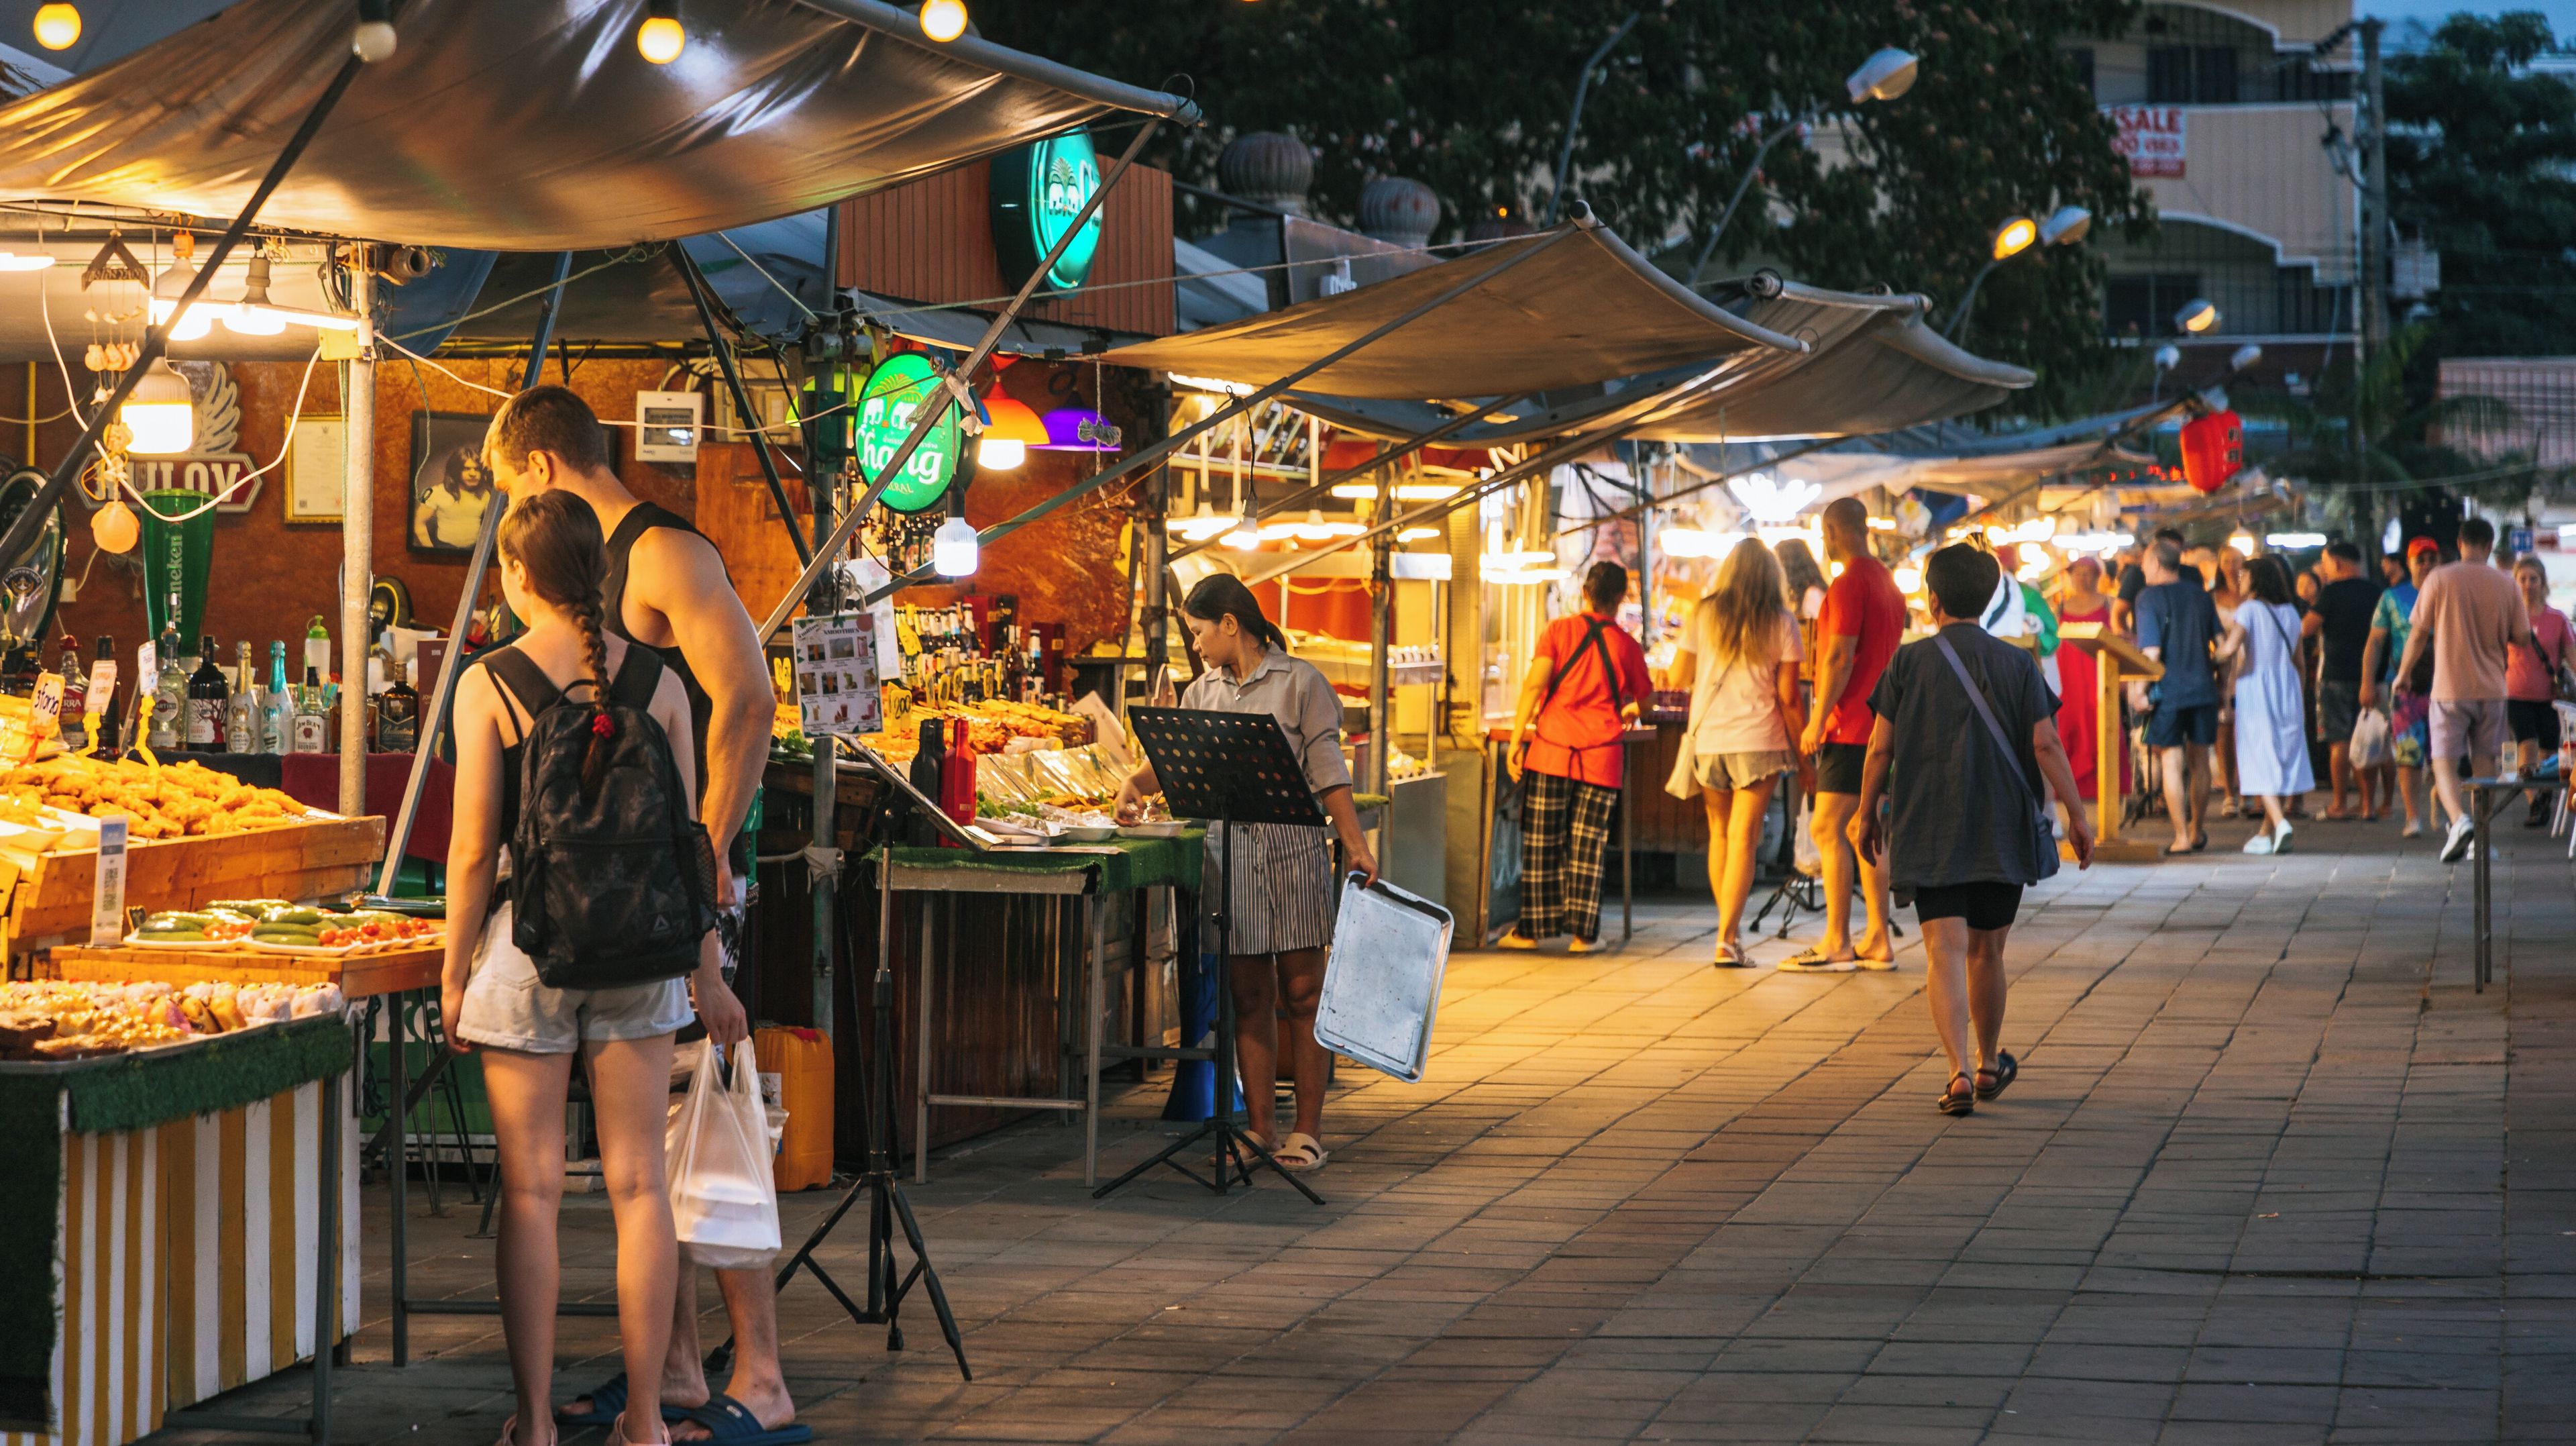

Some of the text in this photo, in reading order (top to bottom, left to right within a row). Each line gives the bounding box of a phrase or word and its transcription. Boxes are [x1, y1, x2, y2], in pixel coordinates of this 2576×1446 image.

[2120, 107, 2182, 133] SALE
[856, 425, 943, 484] Chang
[894, 694, 912, 720] 200
